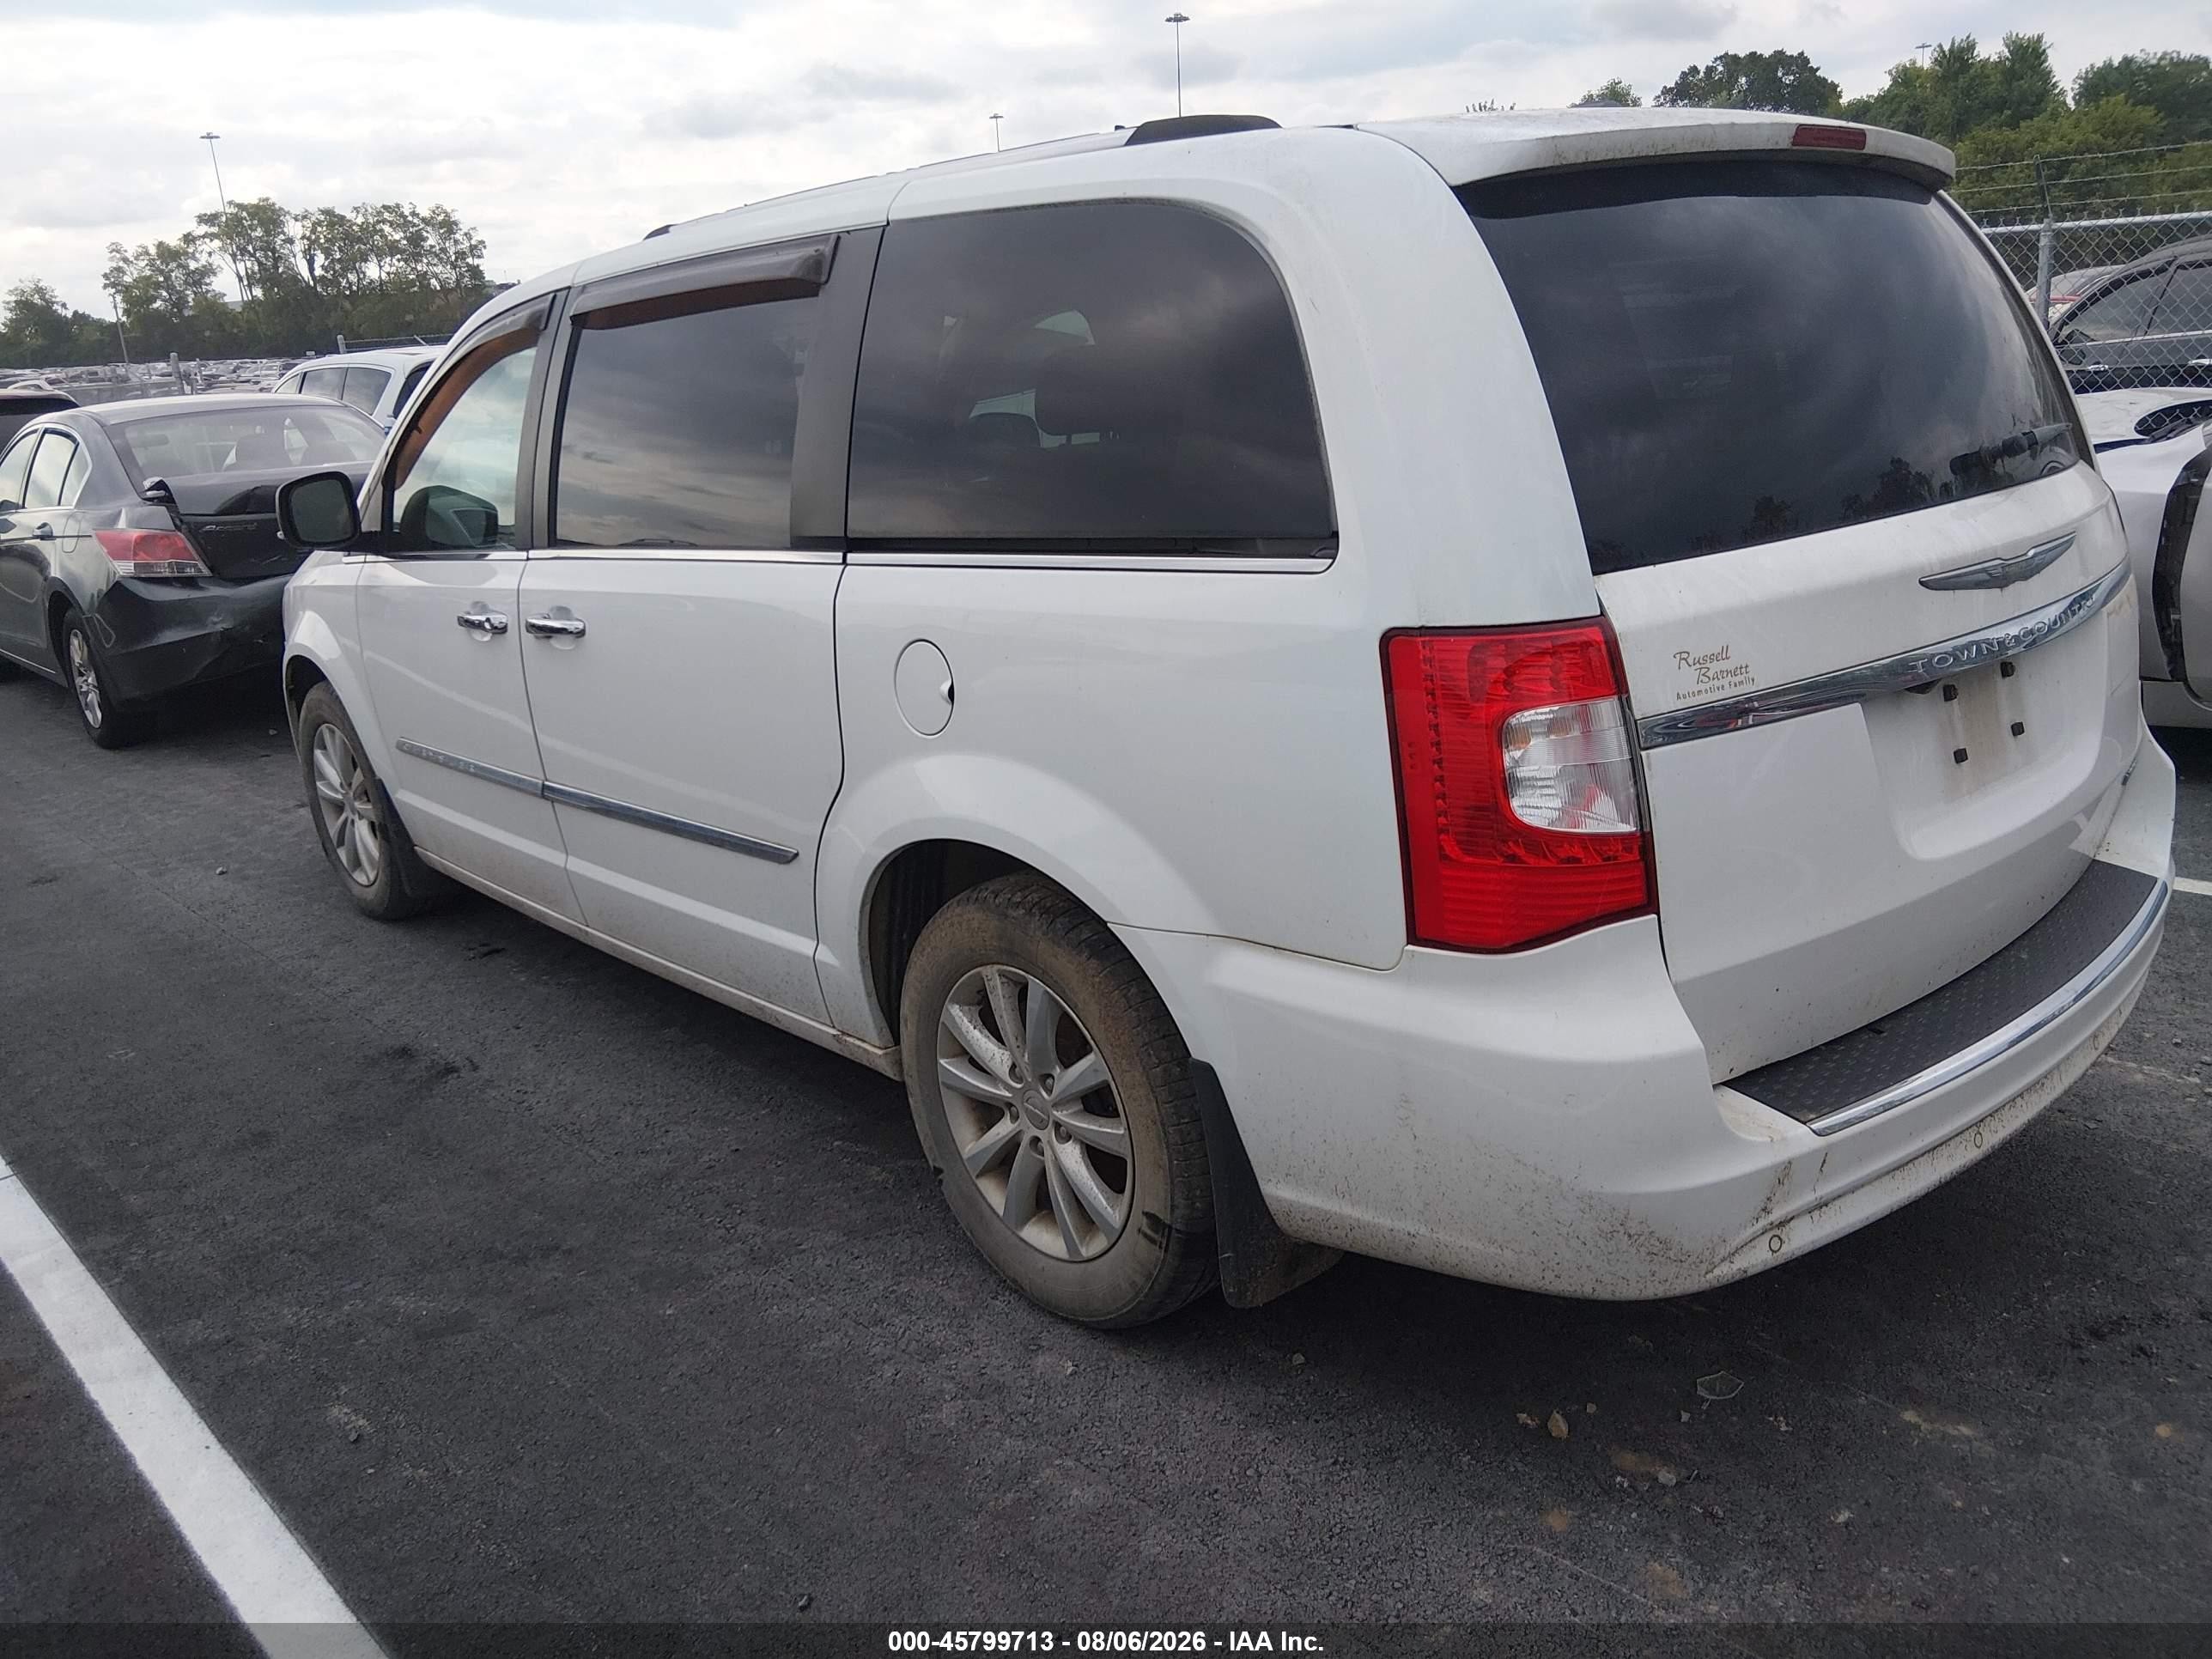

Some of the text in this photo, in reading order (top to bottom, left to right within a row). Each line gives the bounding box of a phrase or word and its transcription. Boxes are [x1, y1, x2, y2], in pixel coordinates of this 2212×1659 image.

[1673, 644, 1731, 670] Russell
[1694, 663, 1750, 684] Barnett
[1676, 676, 1755, 701] Automotive Family
